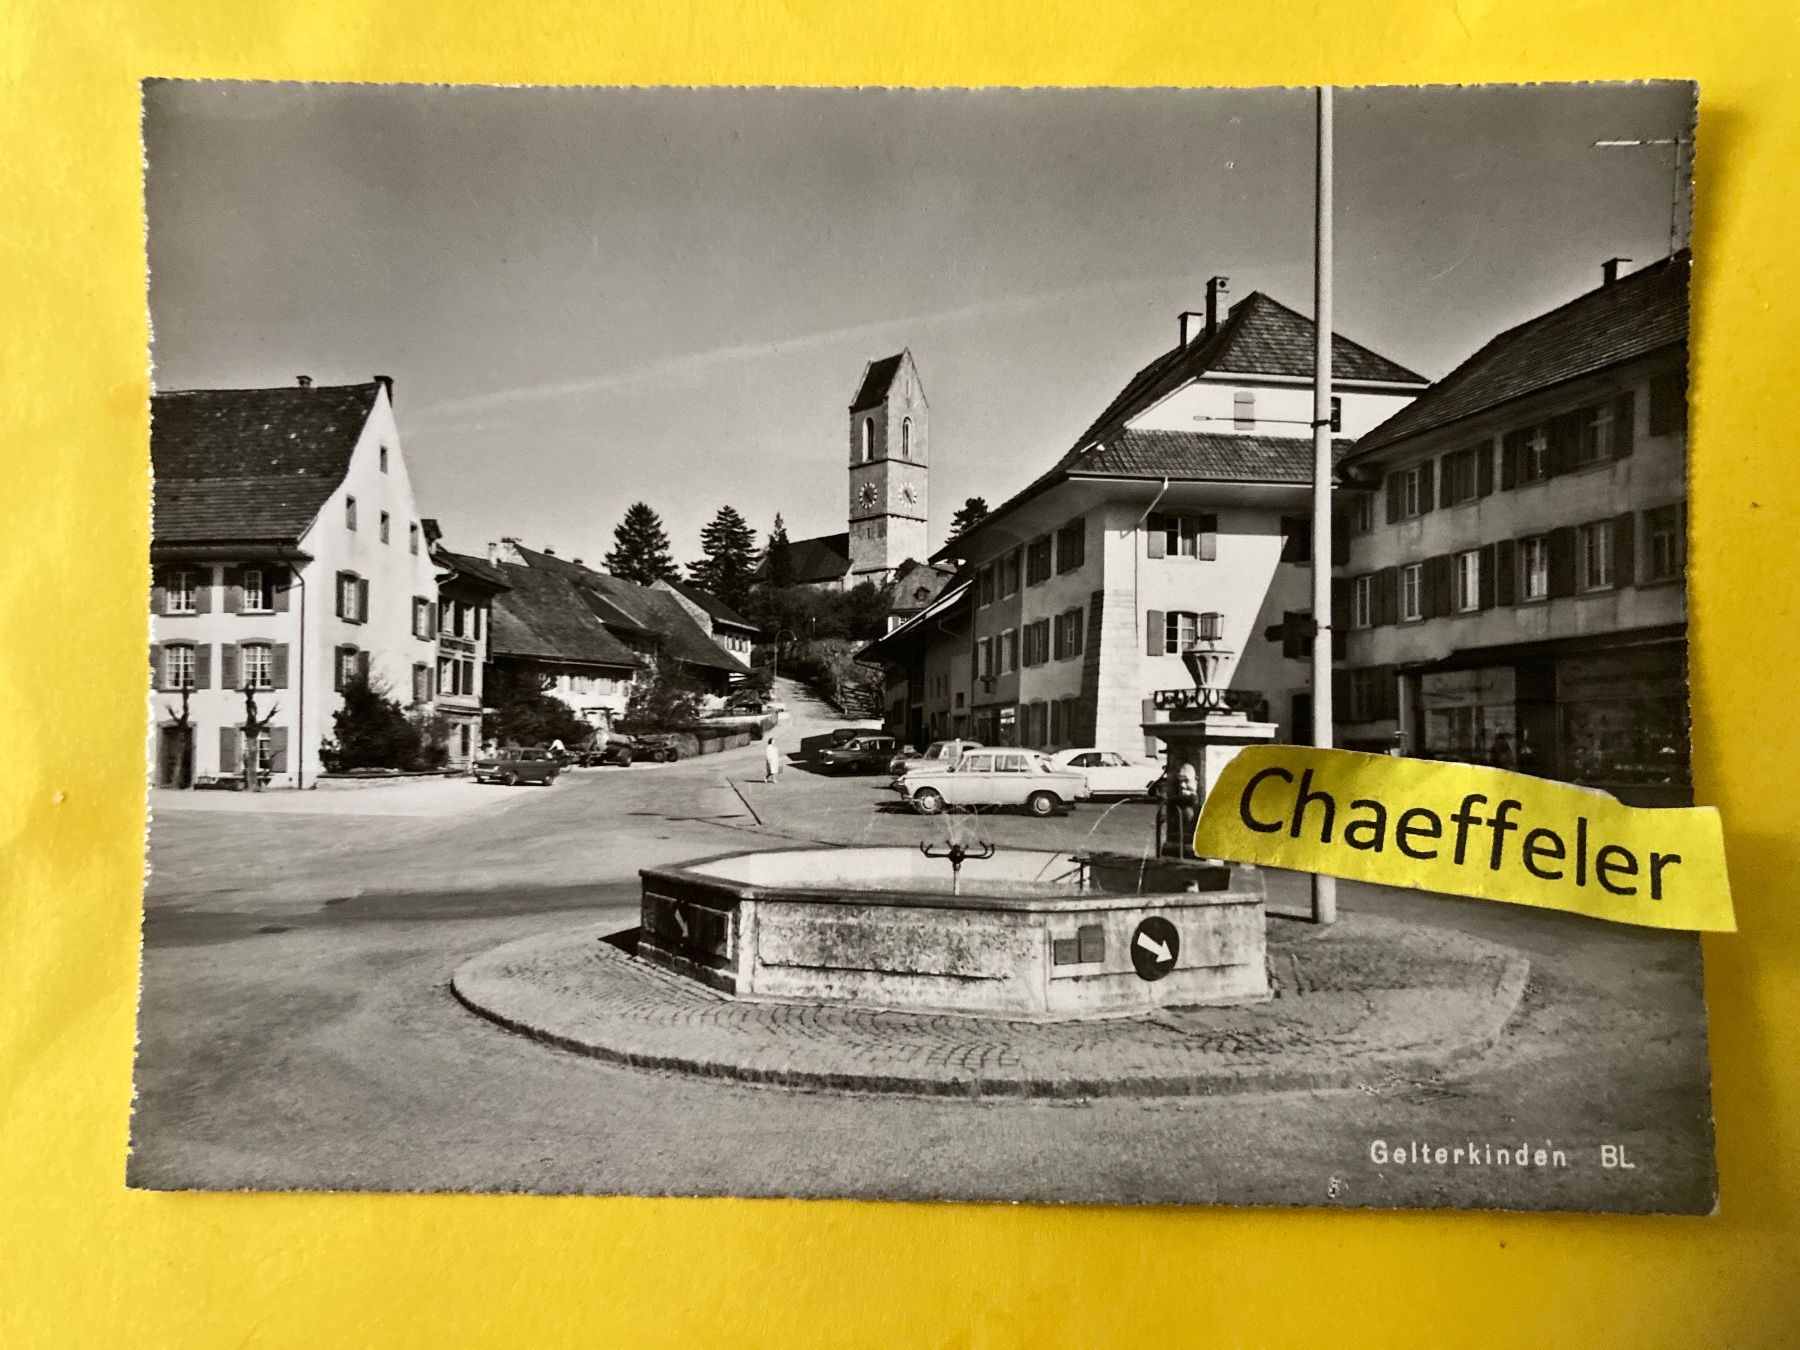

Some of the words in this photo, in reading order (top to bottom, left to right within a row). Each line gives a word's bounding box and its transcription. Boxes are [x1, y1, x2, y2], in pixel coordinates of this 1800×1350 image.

[1239, 767, 1682, 900] Chaeffeler
[1370, 1139, 1567, 1168] Gelterkinden
[1600, 1144, 1636, 1169] BL
